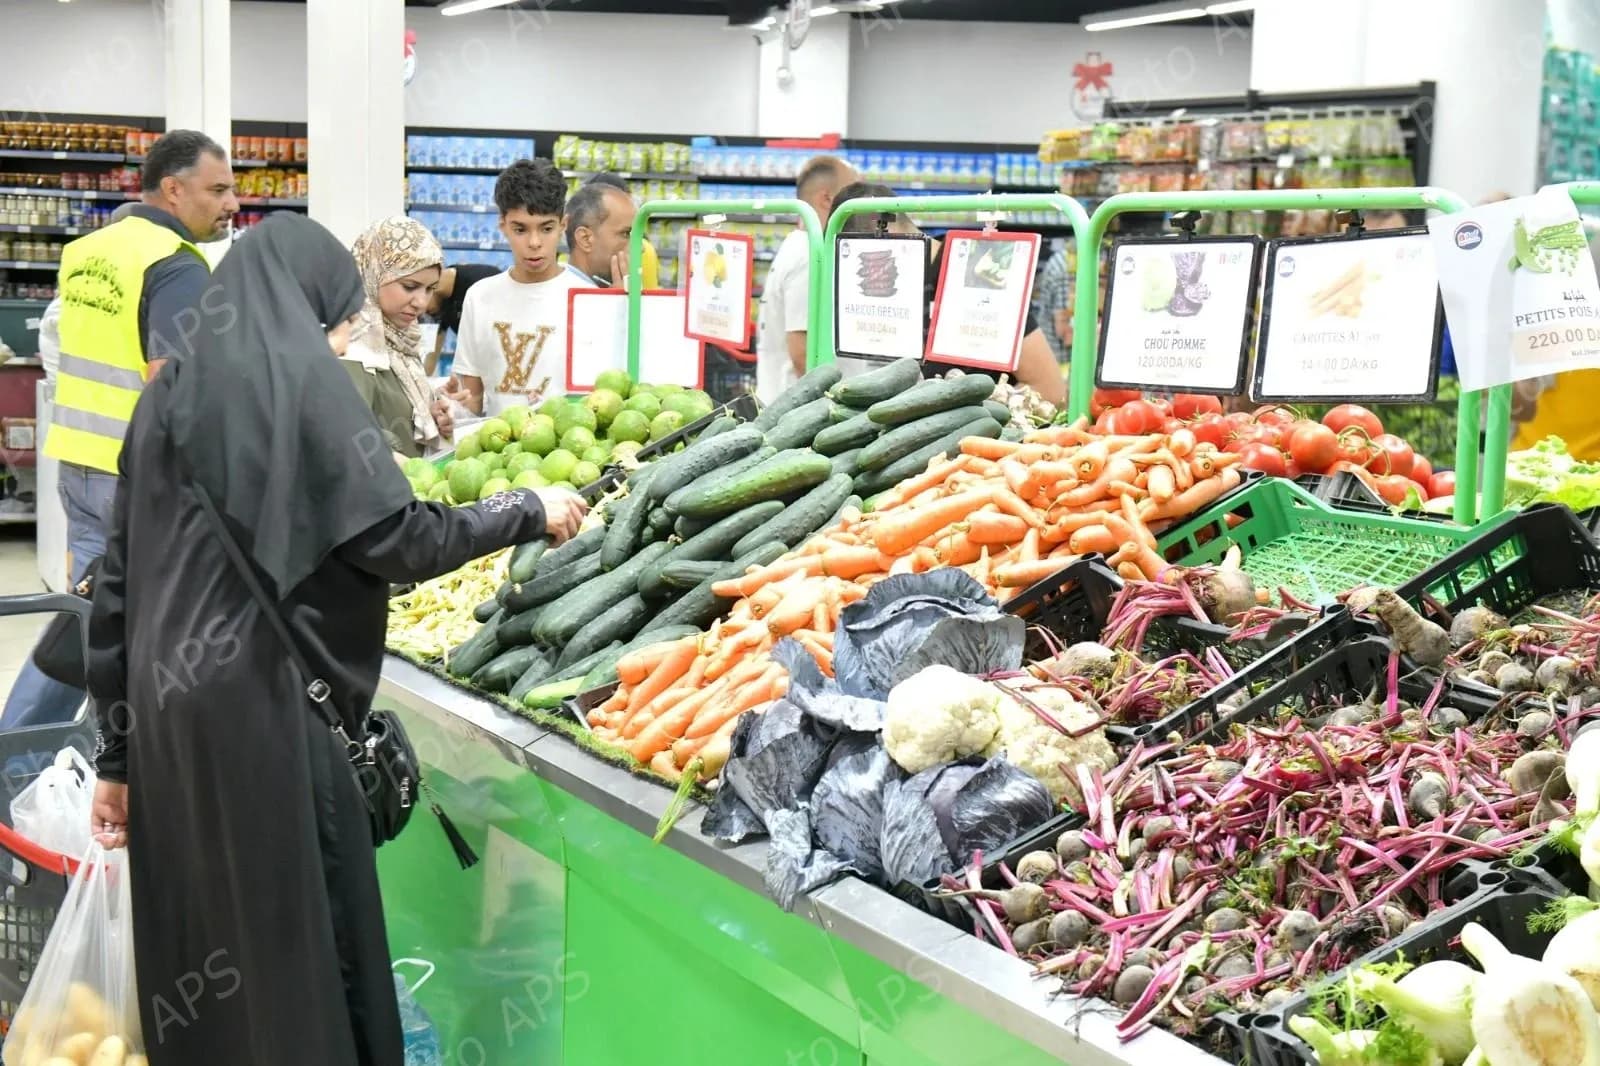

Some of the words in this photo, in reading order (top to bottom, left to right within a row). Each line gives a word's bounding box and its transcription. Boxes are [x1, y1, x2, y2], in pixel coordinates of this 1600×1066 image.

[1515, 308, 1566, 327] PETITS
[1569, 305, 1593, 318] POIS
[1144, 338, 1169, 350] CHOU
[1171, 338, 1206, 350] POMME
[1528, 328, 1584, 349] 220.00
